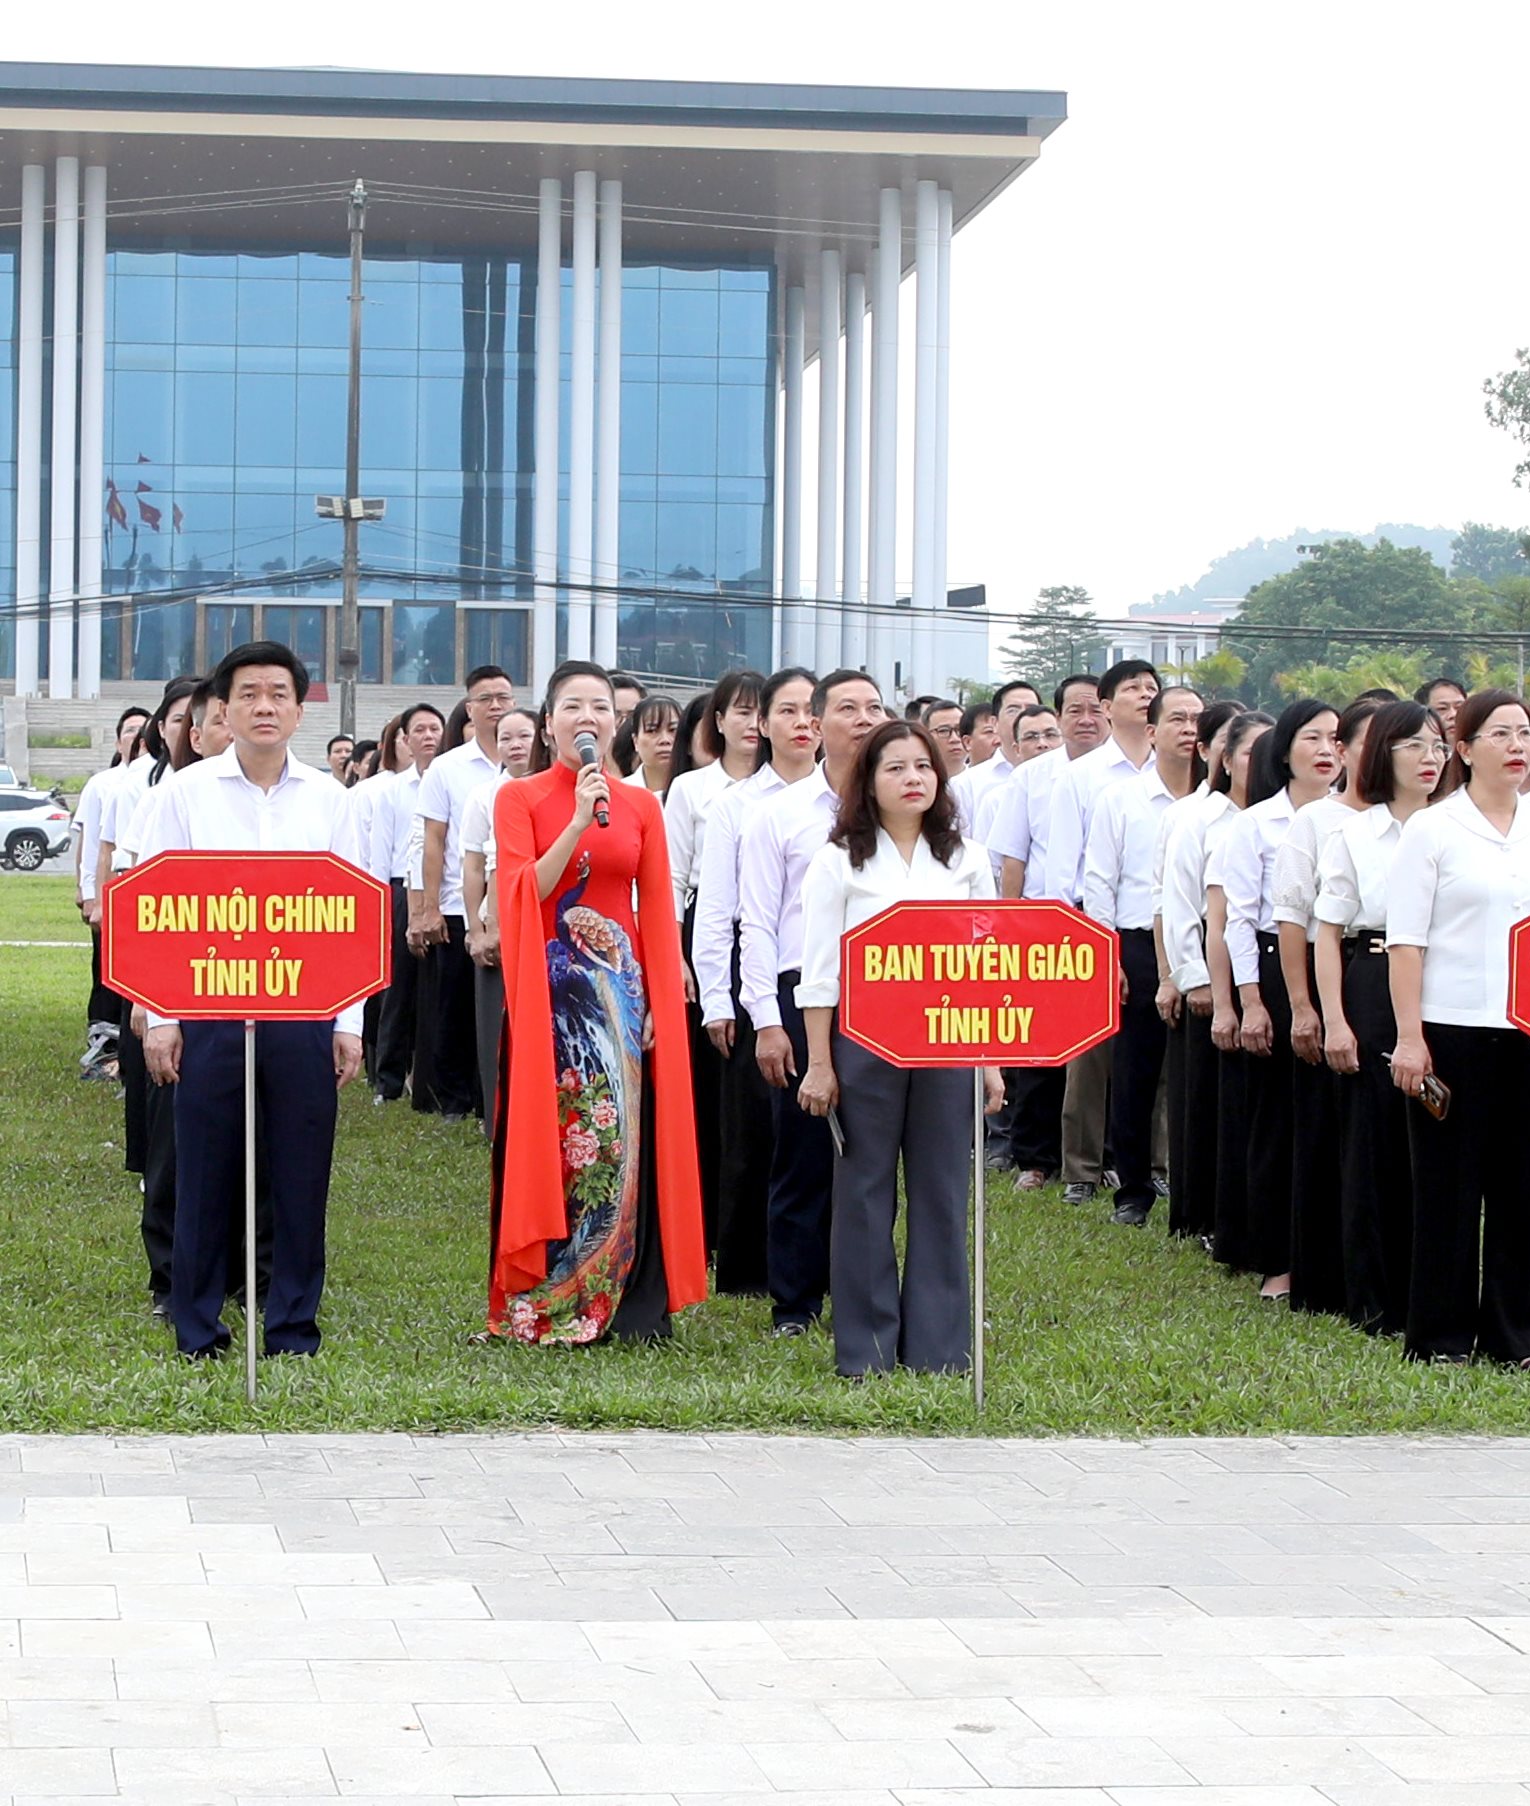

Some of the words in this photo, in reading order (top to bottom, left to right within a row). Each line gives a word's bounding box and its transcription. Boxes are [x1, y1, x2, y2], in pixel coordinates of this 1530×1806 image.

[137, 894, 199, 932] BAN
[206, 886, 257, 941] NỘI
[265, 887, 356, 933] CHÍNH
[189, 946, 258, 997] TỈNH
[265, 946, 303, 997] ỦY
[864, 944, 924, 982] BAN
[929, 936, 1021, 982] TUYÊN
[1027, 935, 1094, 981] GIÁO
[924, 994, 990, 1044] TỈNH
[997, 994, 1034, 1044] ỦY
